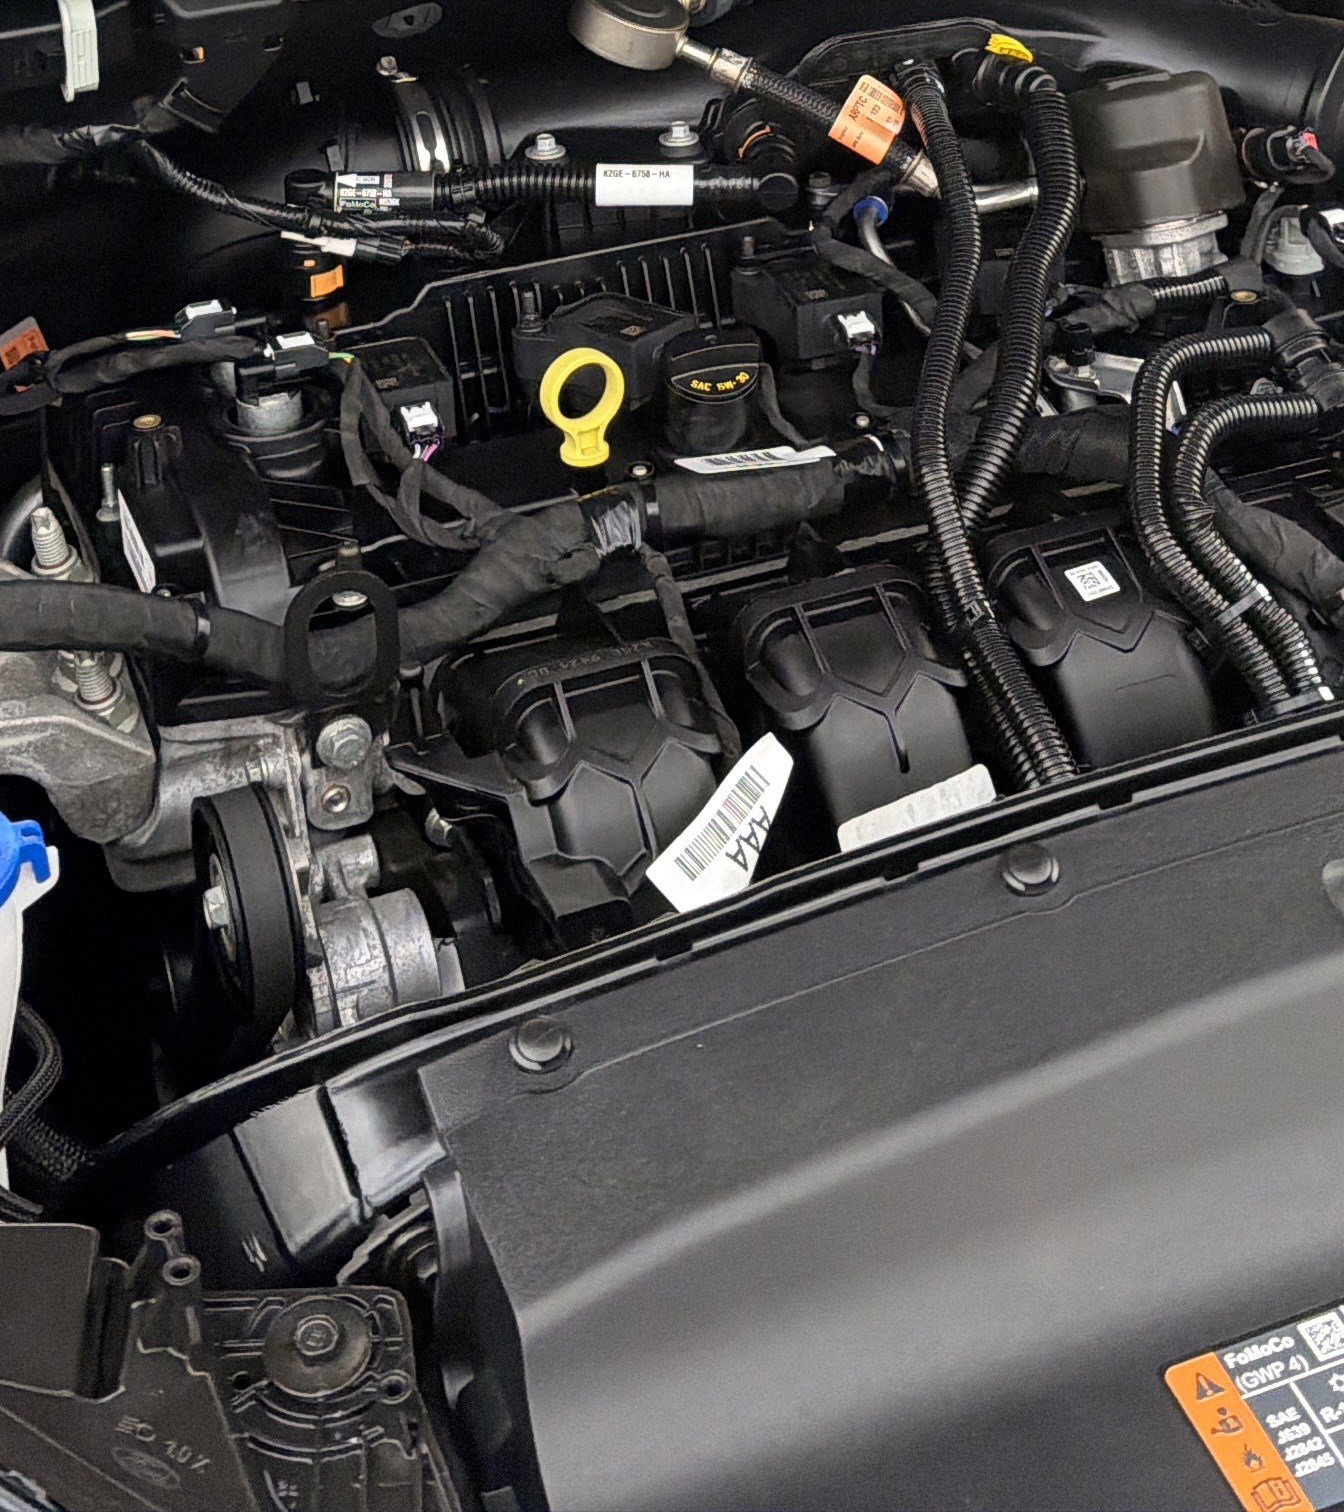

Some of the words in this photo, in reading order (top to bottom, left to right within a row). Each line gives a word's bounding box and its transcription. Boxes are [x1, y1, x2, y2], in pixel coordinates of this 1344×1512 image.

[1223, 1336, 1295, 1369] FoMoCo
[1236, 1362, 1285, 1393] (GWP
[1288, 1354, 1309, 1375] 4)
[1266, 1407, 1301, 1429] SAE
